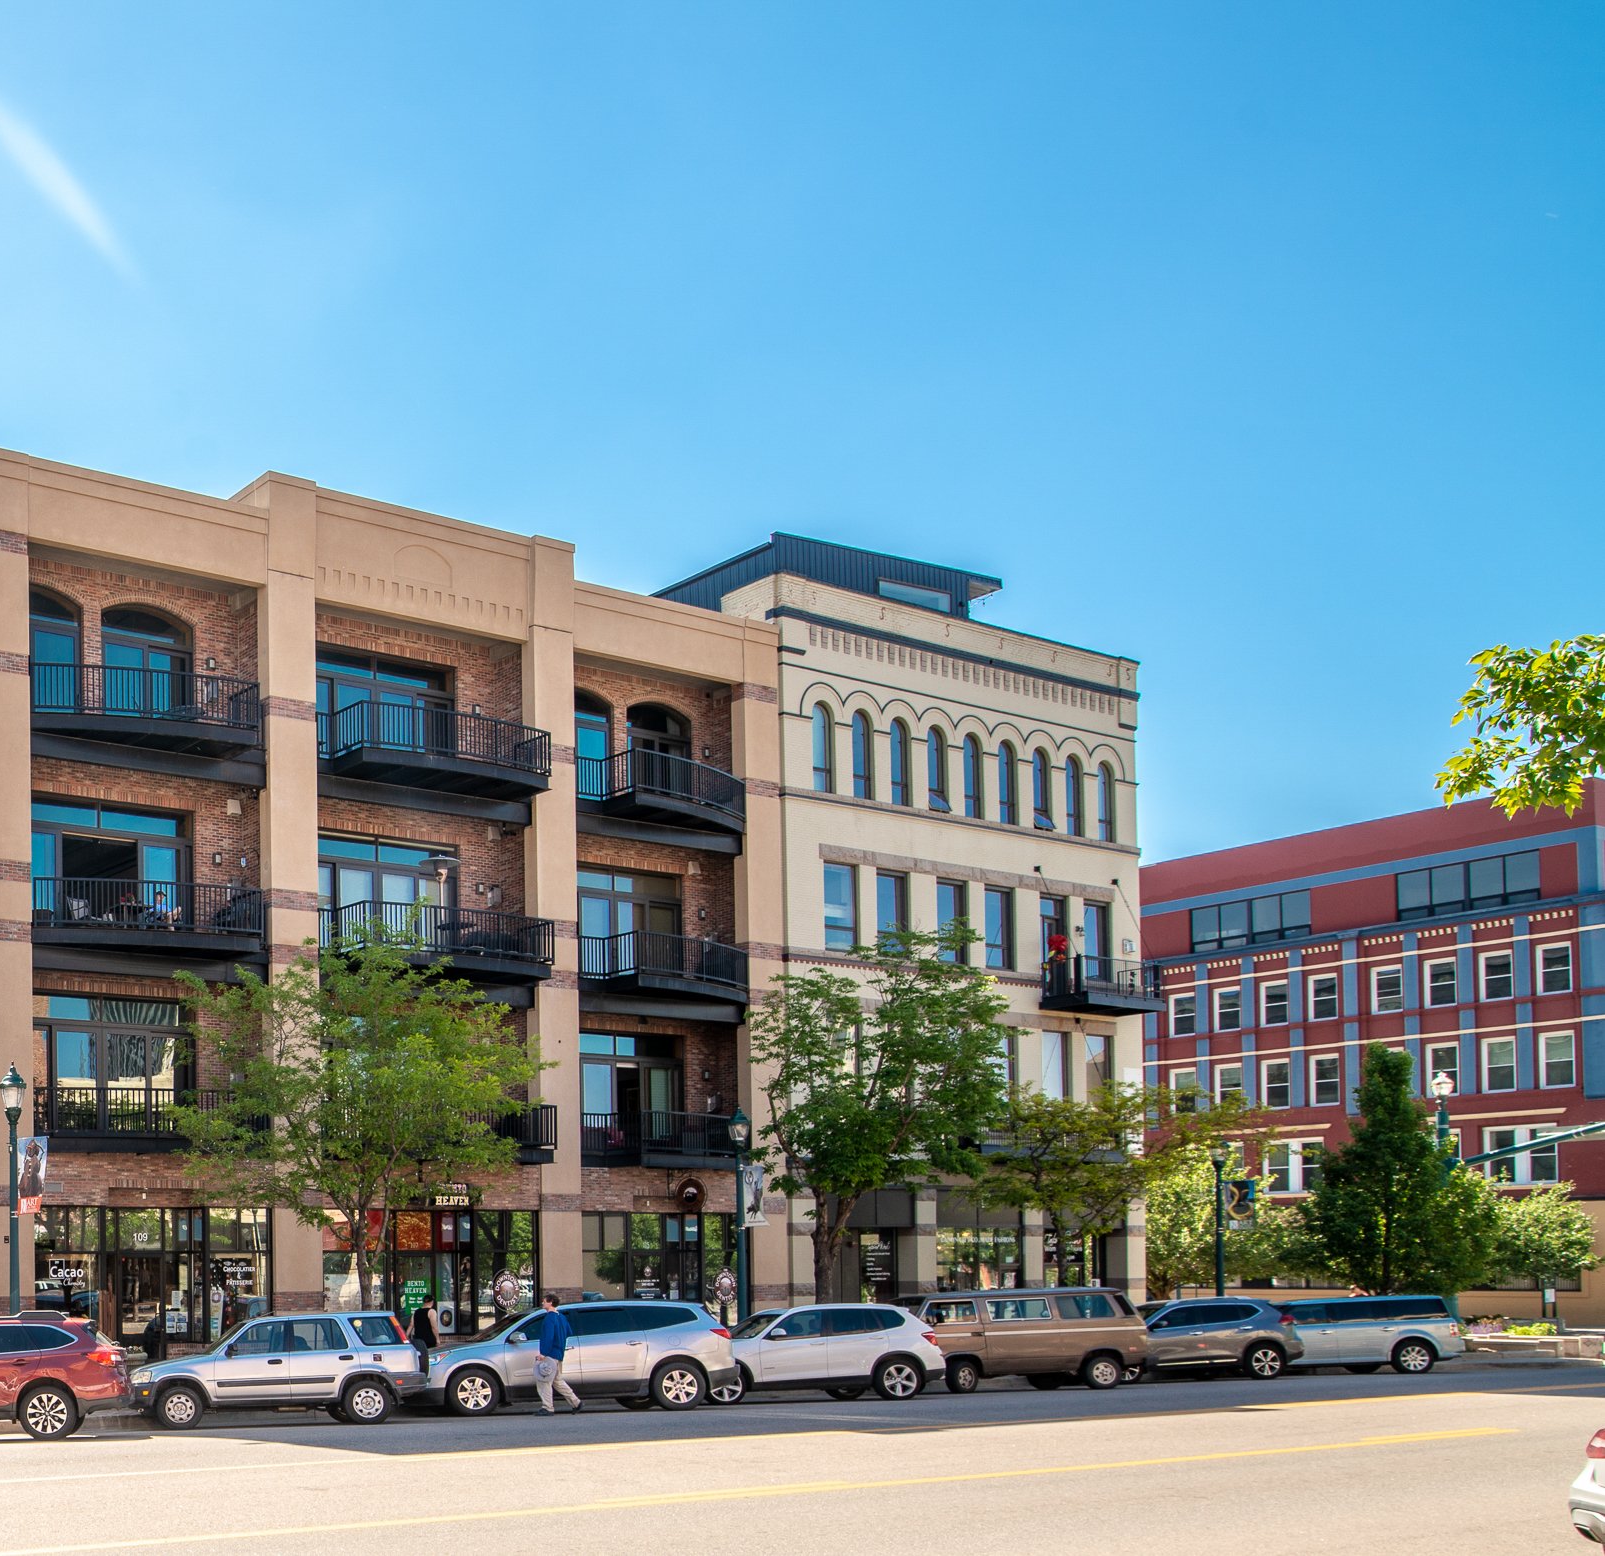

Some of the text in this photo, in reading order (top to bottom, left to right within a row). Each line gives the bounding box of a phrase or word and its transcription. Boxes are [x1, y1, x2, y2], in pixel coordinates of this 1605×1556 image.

[27, 1197, 39, 1206] ART
[435, 1196, 469, 1206] HEAVEN
[133, 1233, 148, 1242] 109
[50, 1266, 84, 1278] Cacao
[495, 1275, 519, 1291] DOWNTOWN
[496, 1294, 517, 1306] DENTIST
